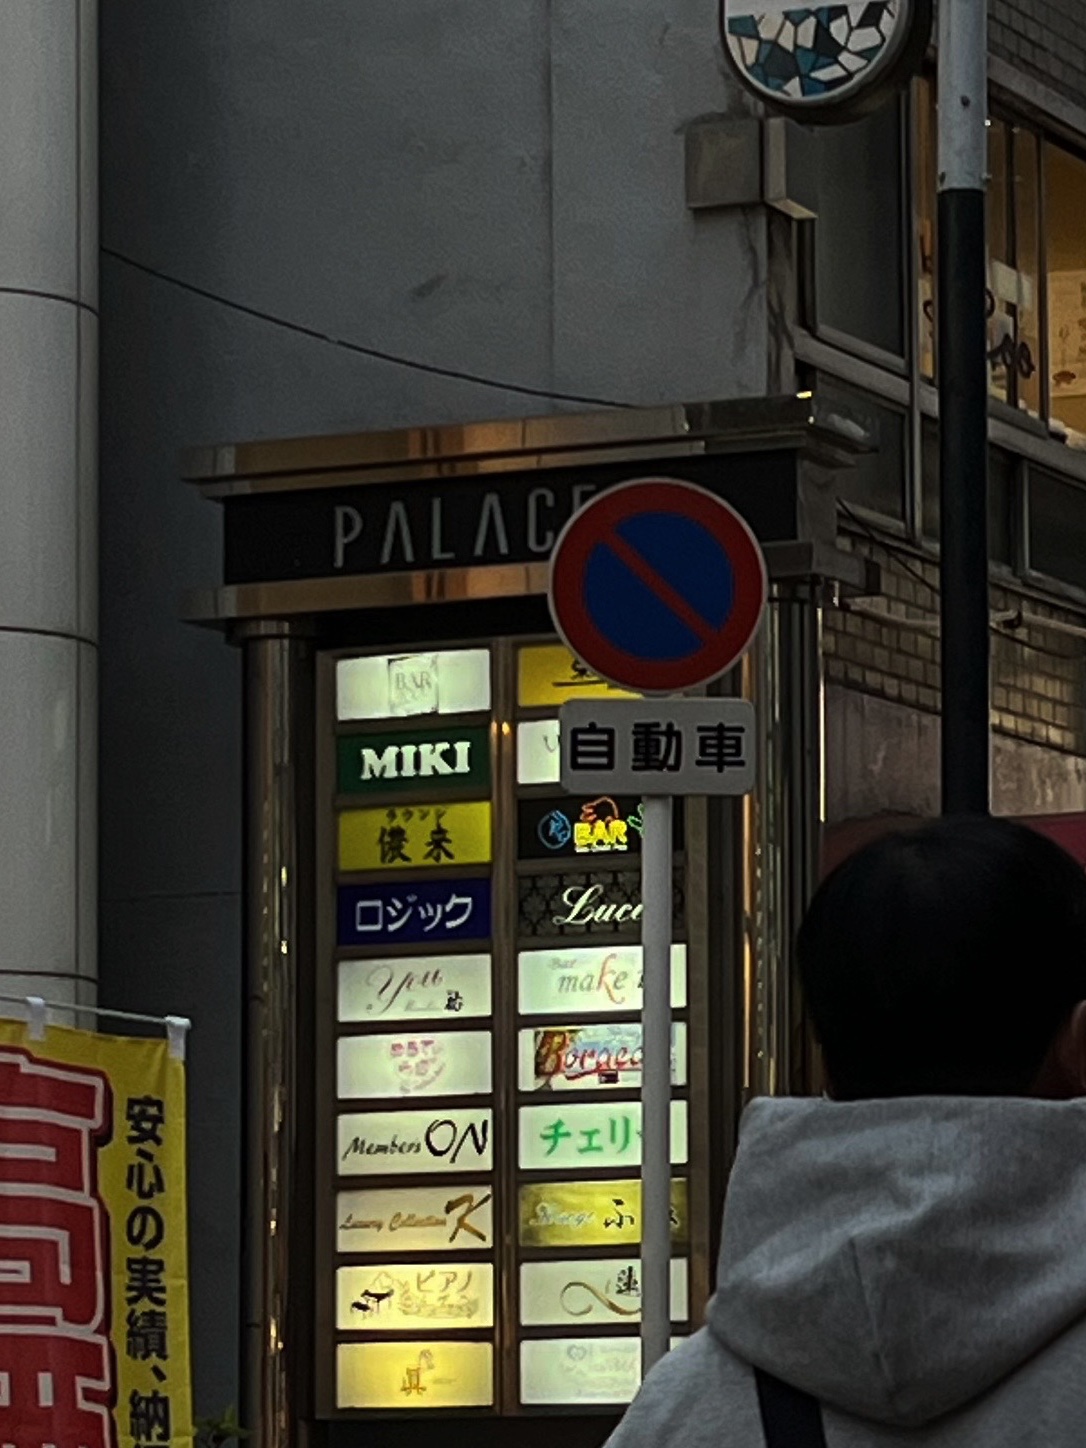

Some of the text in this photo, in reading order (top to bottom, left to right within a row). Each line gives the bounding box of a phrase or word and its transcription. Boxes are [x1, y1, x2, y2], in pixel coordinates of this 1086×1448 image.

[360, 741, 471, 780] MIKI
[570, 720, 746, 773] 自動車
[574, 820, 628, 845] BAR
[356, 894, 472, 932] ロジック
[425, 1119, 488, 1163] ON
[540, 1116, 643, 1157] チェリ
